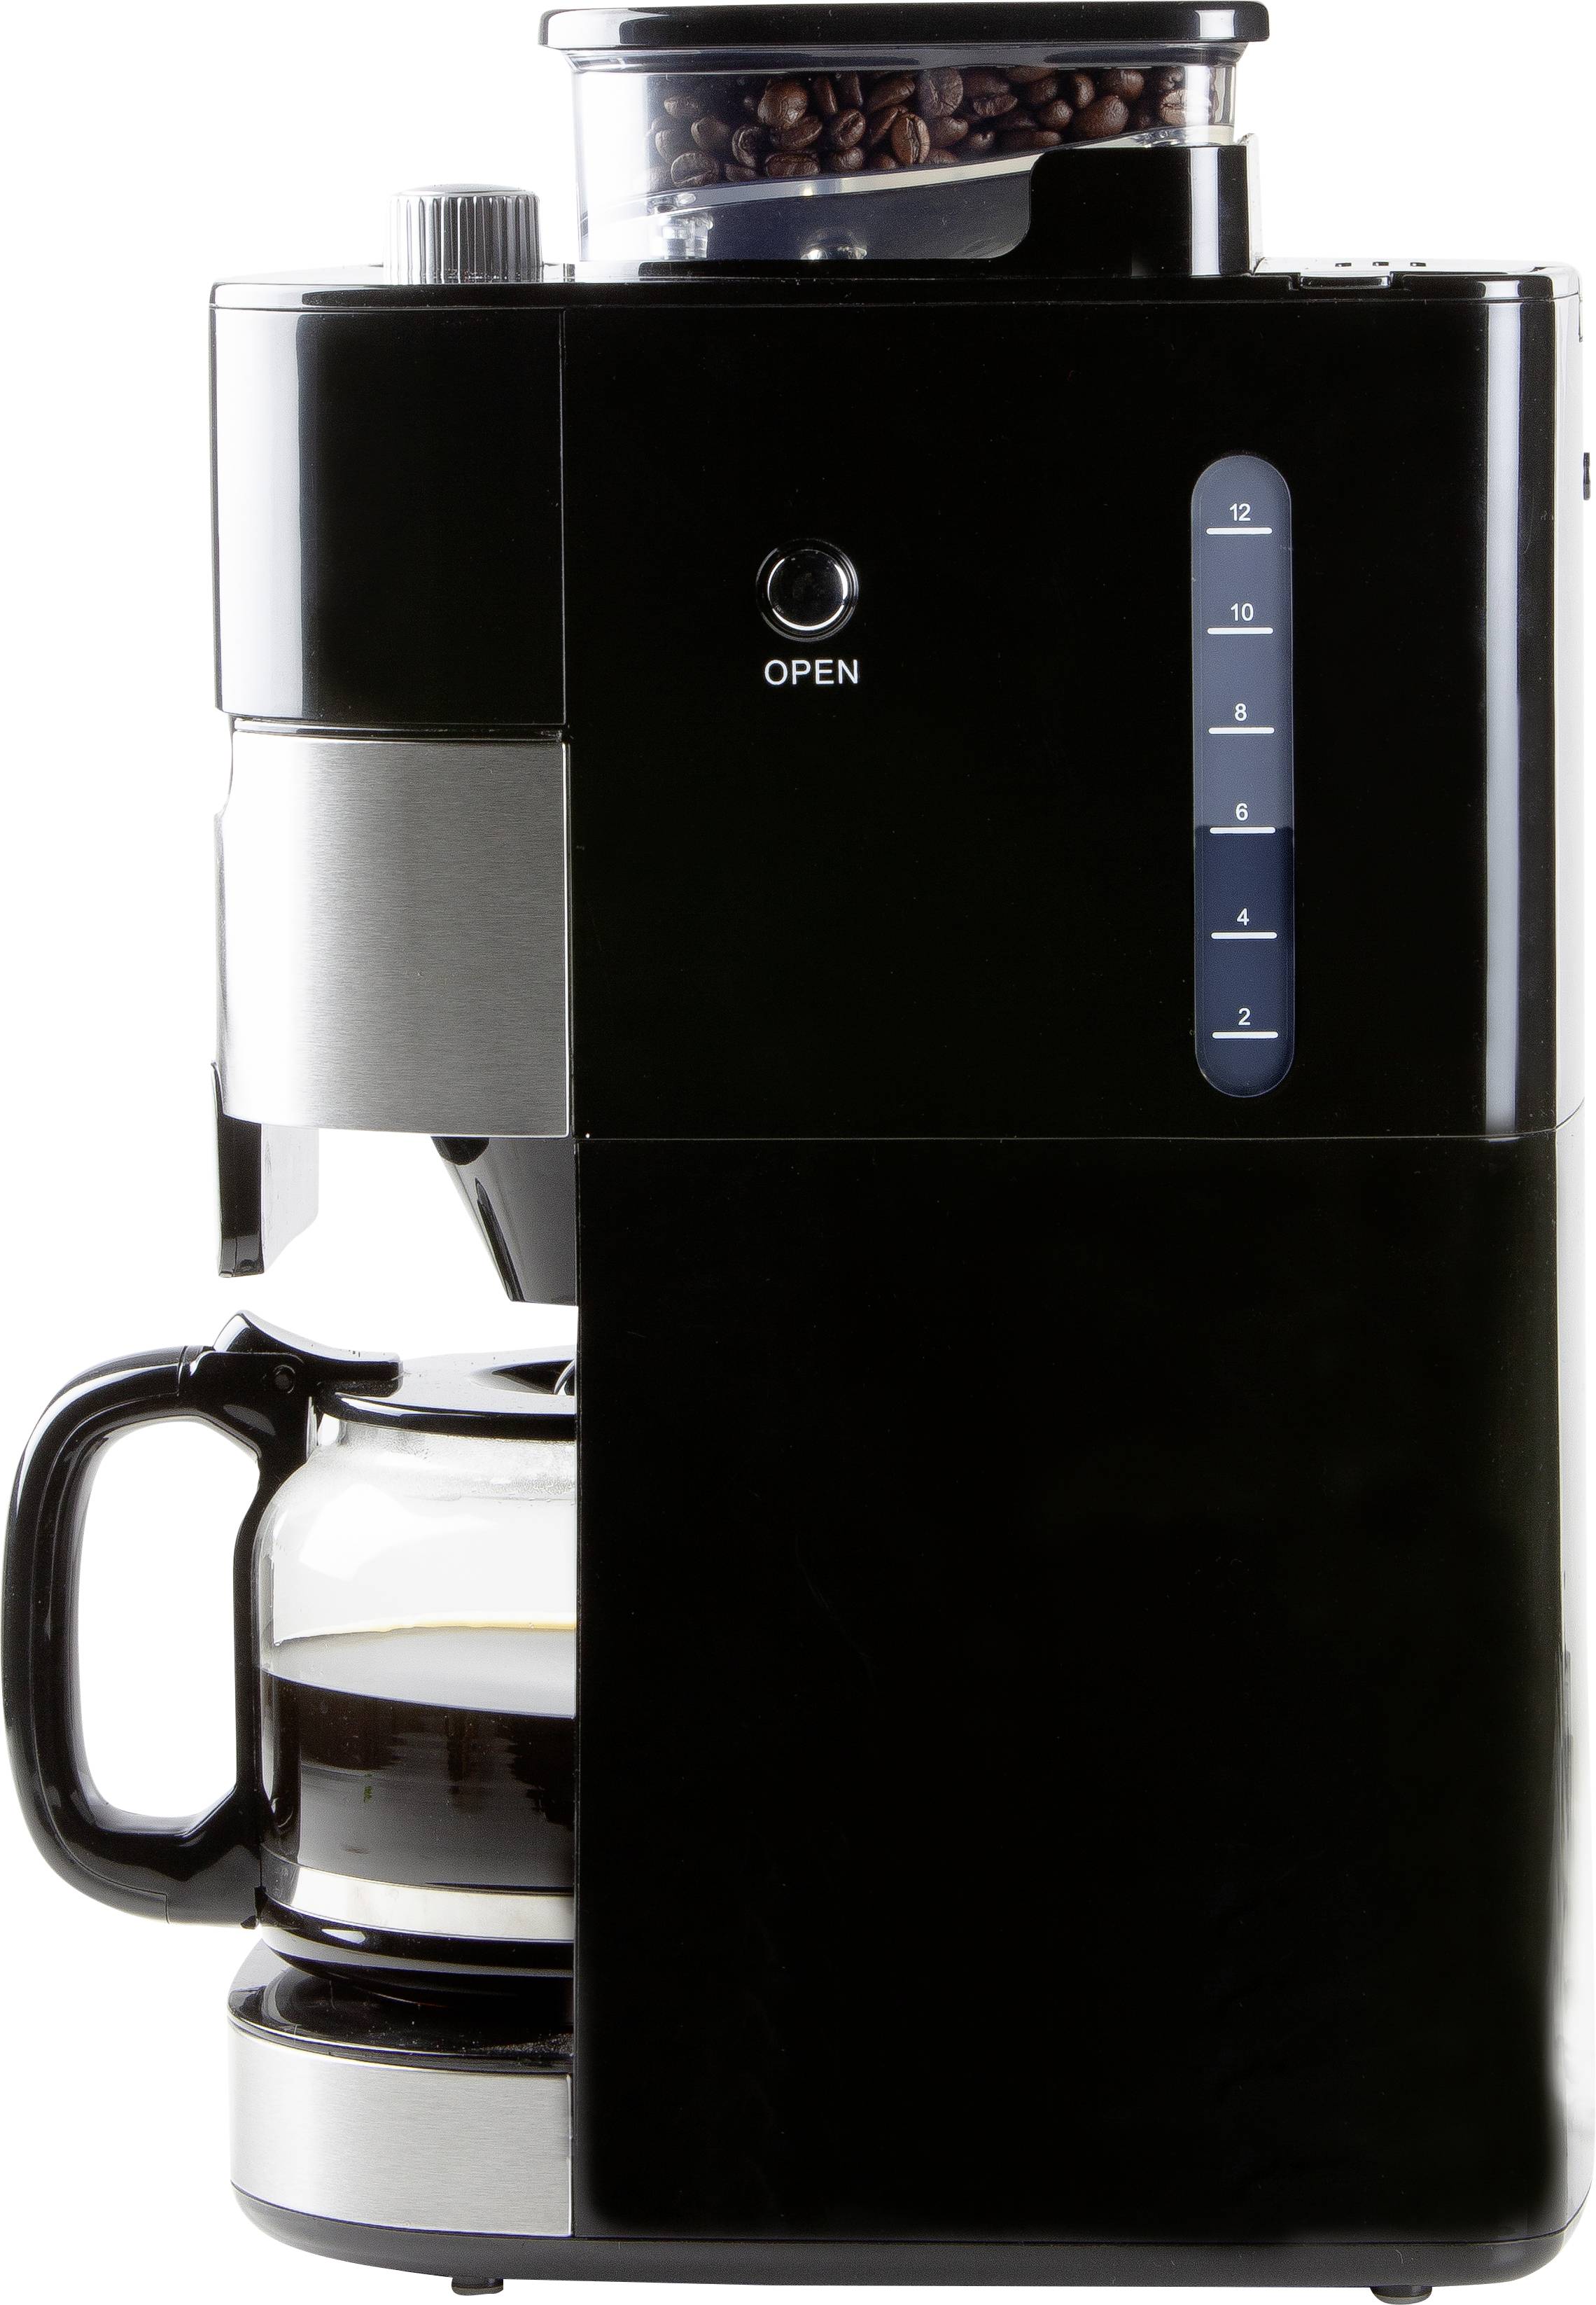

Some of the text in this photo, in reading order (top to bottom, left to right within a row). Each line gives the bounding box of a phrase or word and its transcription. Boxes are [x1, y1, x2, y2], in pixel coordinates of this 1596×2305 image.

[1228, 502, 1252, 522] 12
[1230, 602, 1254, 622] 10
[764, 658, 859, 686] OPEN
[1234, 702, 1247, 722] 8
[1235, 802, 1249, 821] 6
[1236, 907, 1250, 926] 4
[1238, 1007, 1251, 1026] 2
